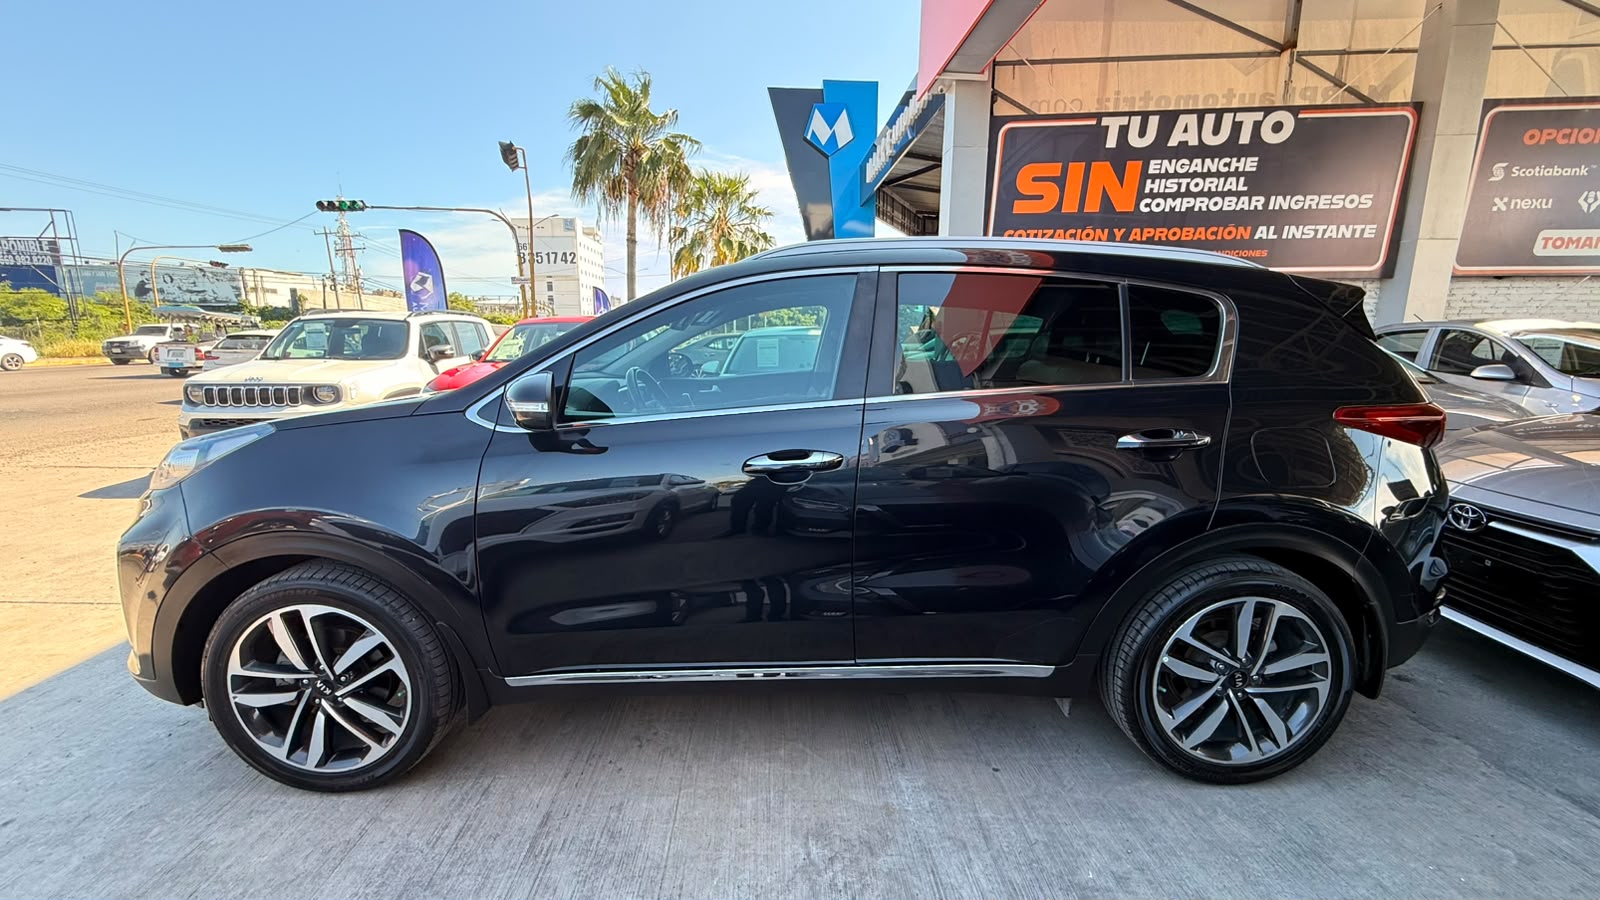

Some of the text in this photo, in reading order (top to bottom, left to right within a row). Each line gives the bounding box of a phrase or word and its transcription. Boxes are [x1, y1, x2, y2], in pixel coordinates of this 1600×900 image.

[1101, 110, 1295, 148] TU AUTO
[1148, 157, 1259, 174] ENGANCHE
[1511, 165, 1588, 177] Scotiabank
[1012, 160, 1143, 214] SIN
[1144, 177, 1248, 193] HISTORIAL
[1139, 194, 1374, 212] COMPROBAR INGRESOS
[1510, 198, 1552, 209] nexu
[1003, 224, 1377, 241] COTIZACIÓN Y APROBACIÓN AL INSTANTE
[315, 680, 332, 695] KIA
[1235, 672, 1243, 687] KIA
